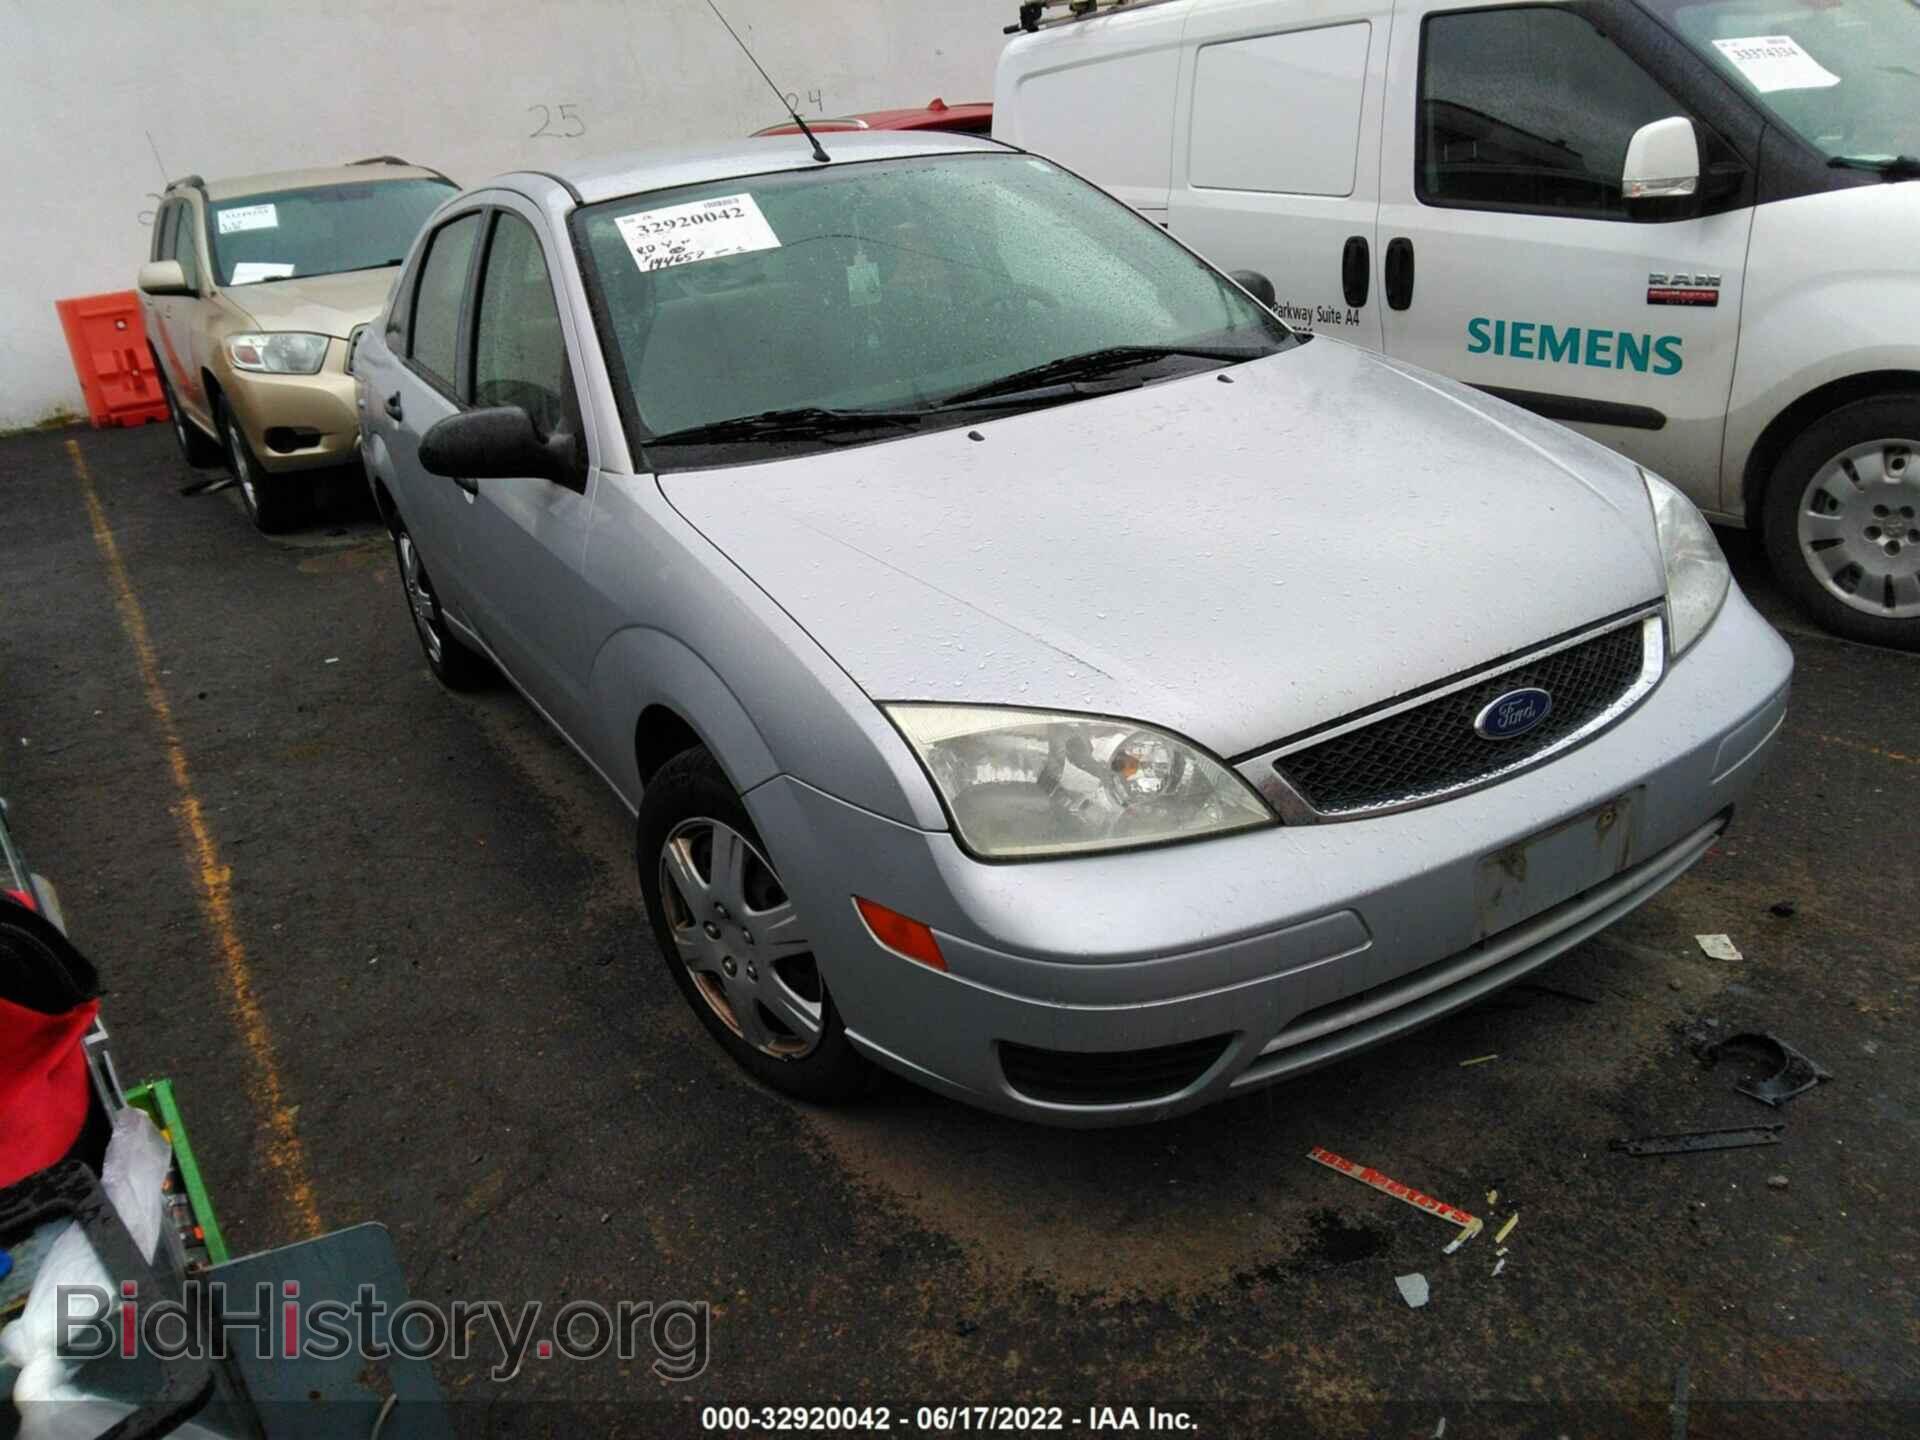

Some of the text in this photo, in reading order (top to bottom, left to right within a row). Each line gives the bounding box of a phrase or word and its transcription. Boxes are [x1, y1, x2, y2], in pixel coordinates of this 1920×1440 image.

[527, 104, 586, 138] 25
[637, 206, 745, 235] 32920042
[1648, 273, 1721, 287] RAM
[1272, 301, 1360, 326] Parkway Suite A4
[1467, 317, 1684, 376] SIEMENS
[1497, 699, 1537, 728] Ford
